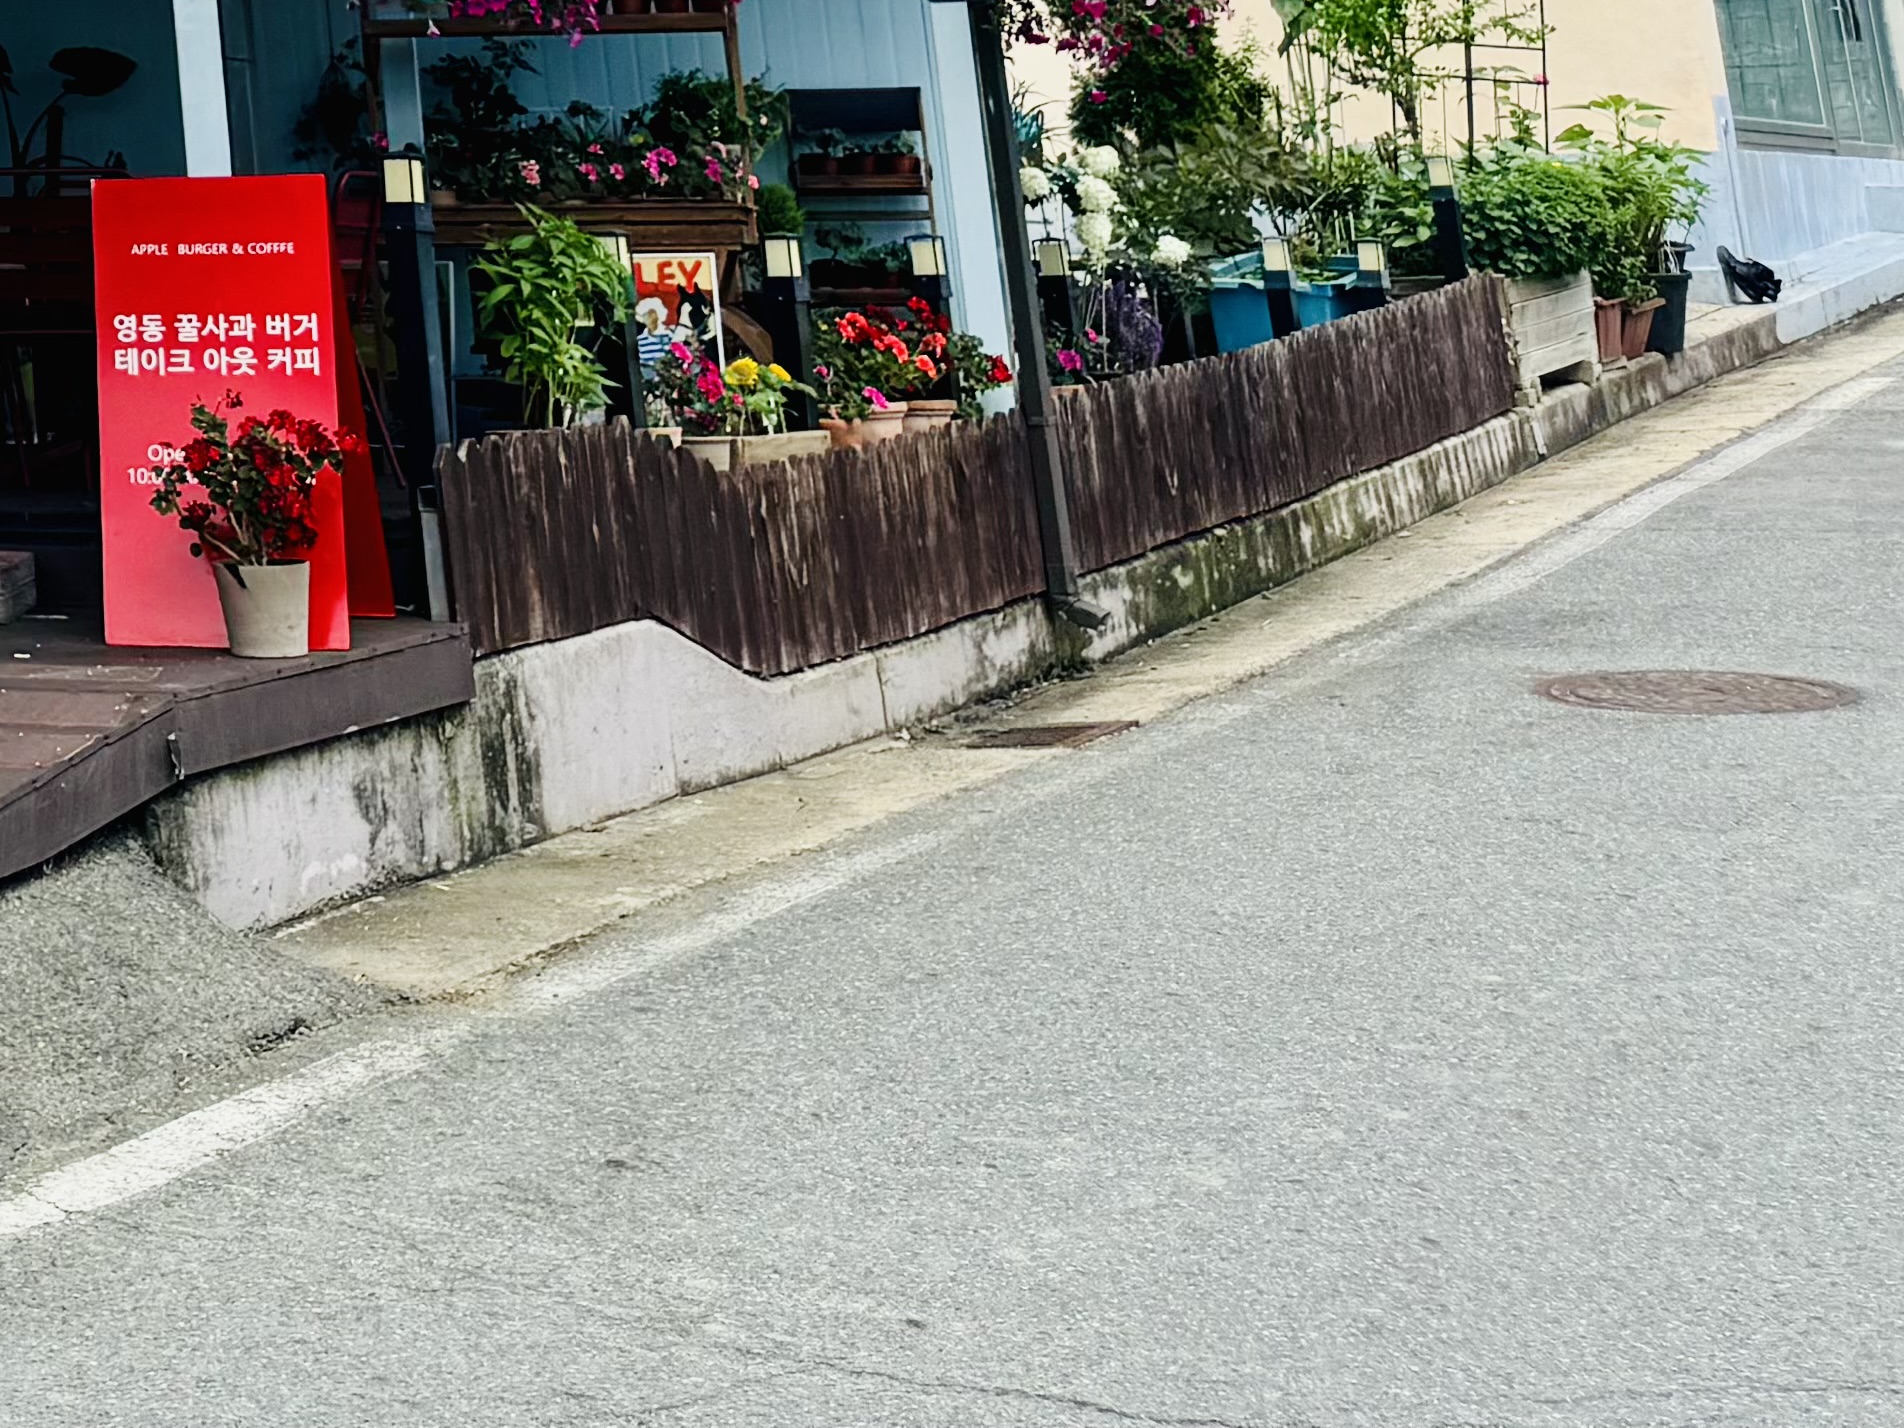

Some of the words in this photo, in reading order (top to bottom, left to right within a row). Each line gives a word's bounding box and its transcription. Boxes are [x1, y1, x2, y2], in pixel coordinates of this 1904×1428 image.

[131, 243, 168, 256] APPLE
[177, 243, 228, 255] BURGER
[232, 243, 244, 255] &
[113, 313, 166, 342] 영동
[173, 312, 256, 342] 꿀사과
[265, 312, 319, 342] 버거
[114, 347, 195, 376] 테이크
[203, 346, 258, 376] 아웃
[267, 346, 321, 376] 커피
